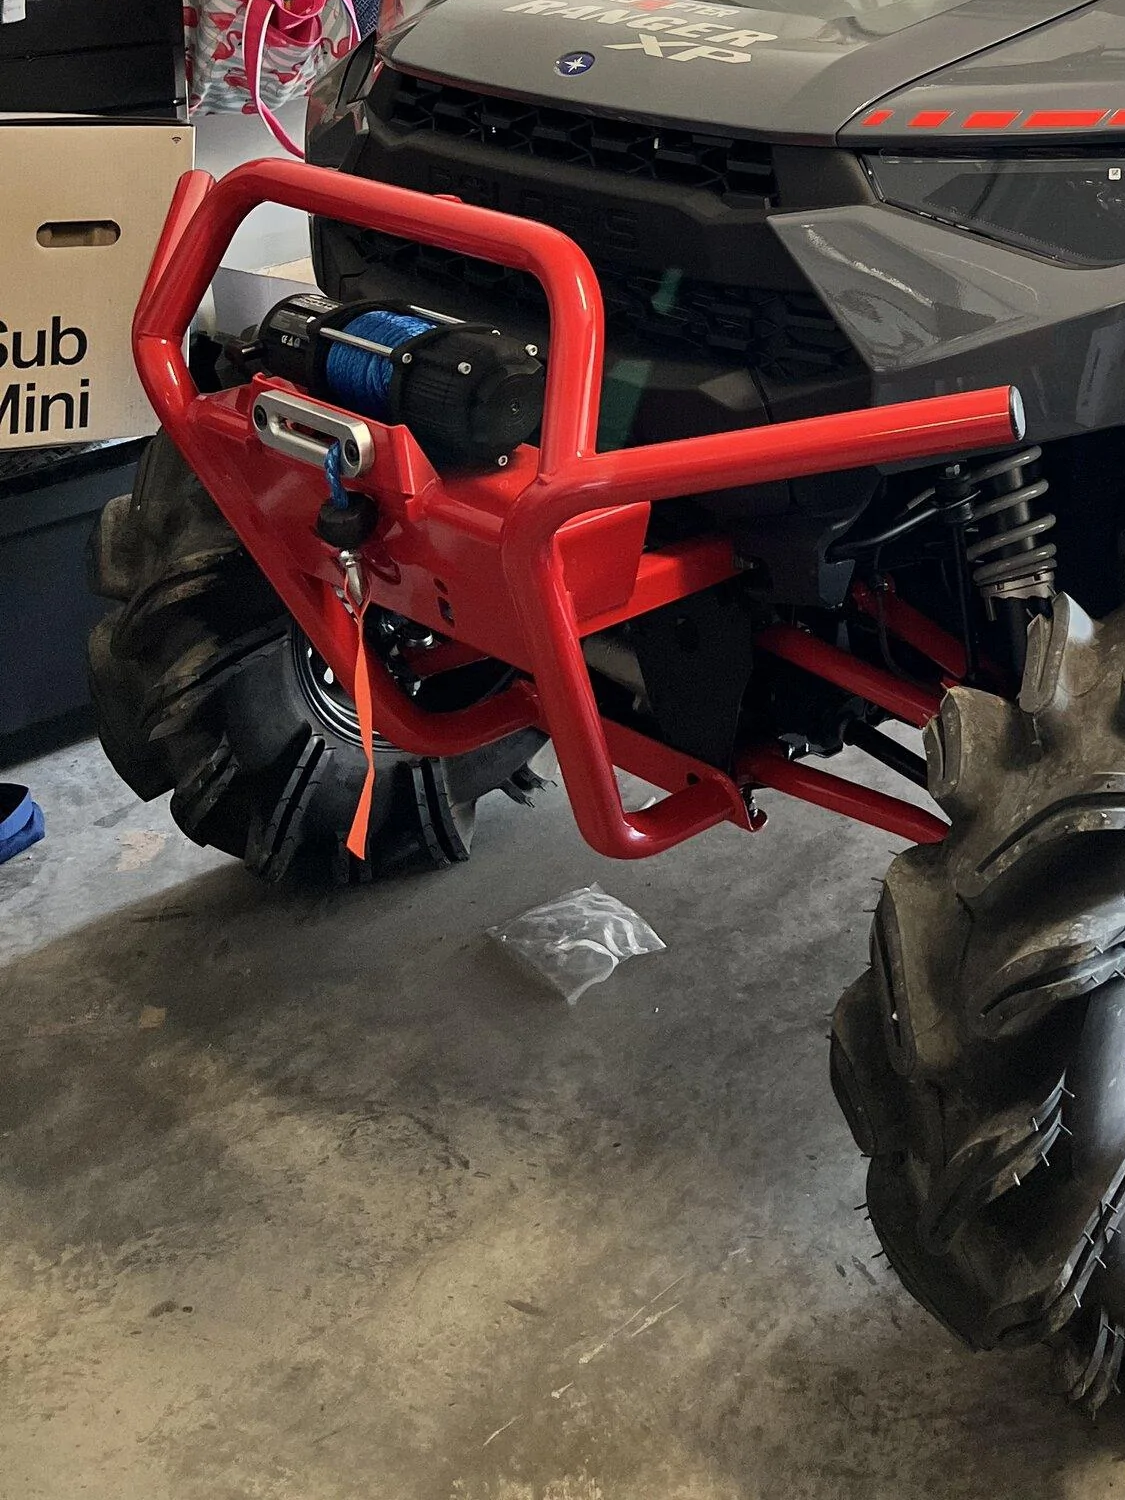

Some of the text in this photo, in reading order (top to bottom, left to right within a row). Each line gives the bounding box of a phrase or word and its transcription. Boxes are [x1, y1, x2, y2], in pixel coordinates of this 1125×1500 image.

[502, 0, 779, 48] RANGER
[602, 33, 752, 64] XP
[0, 316, 87, 368] ub
